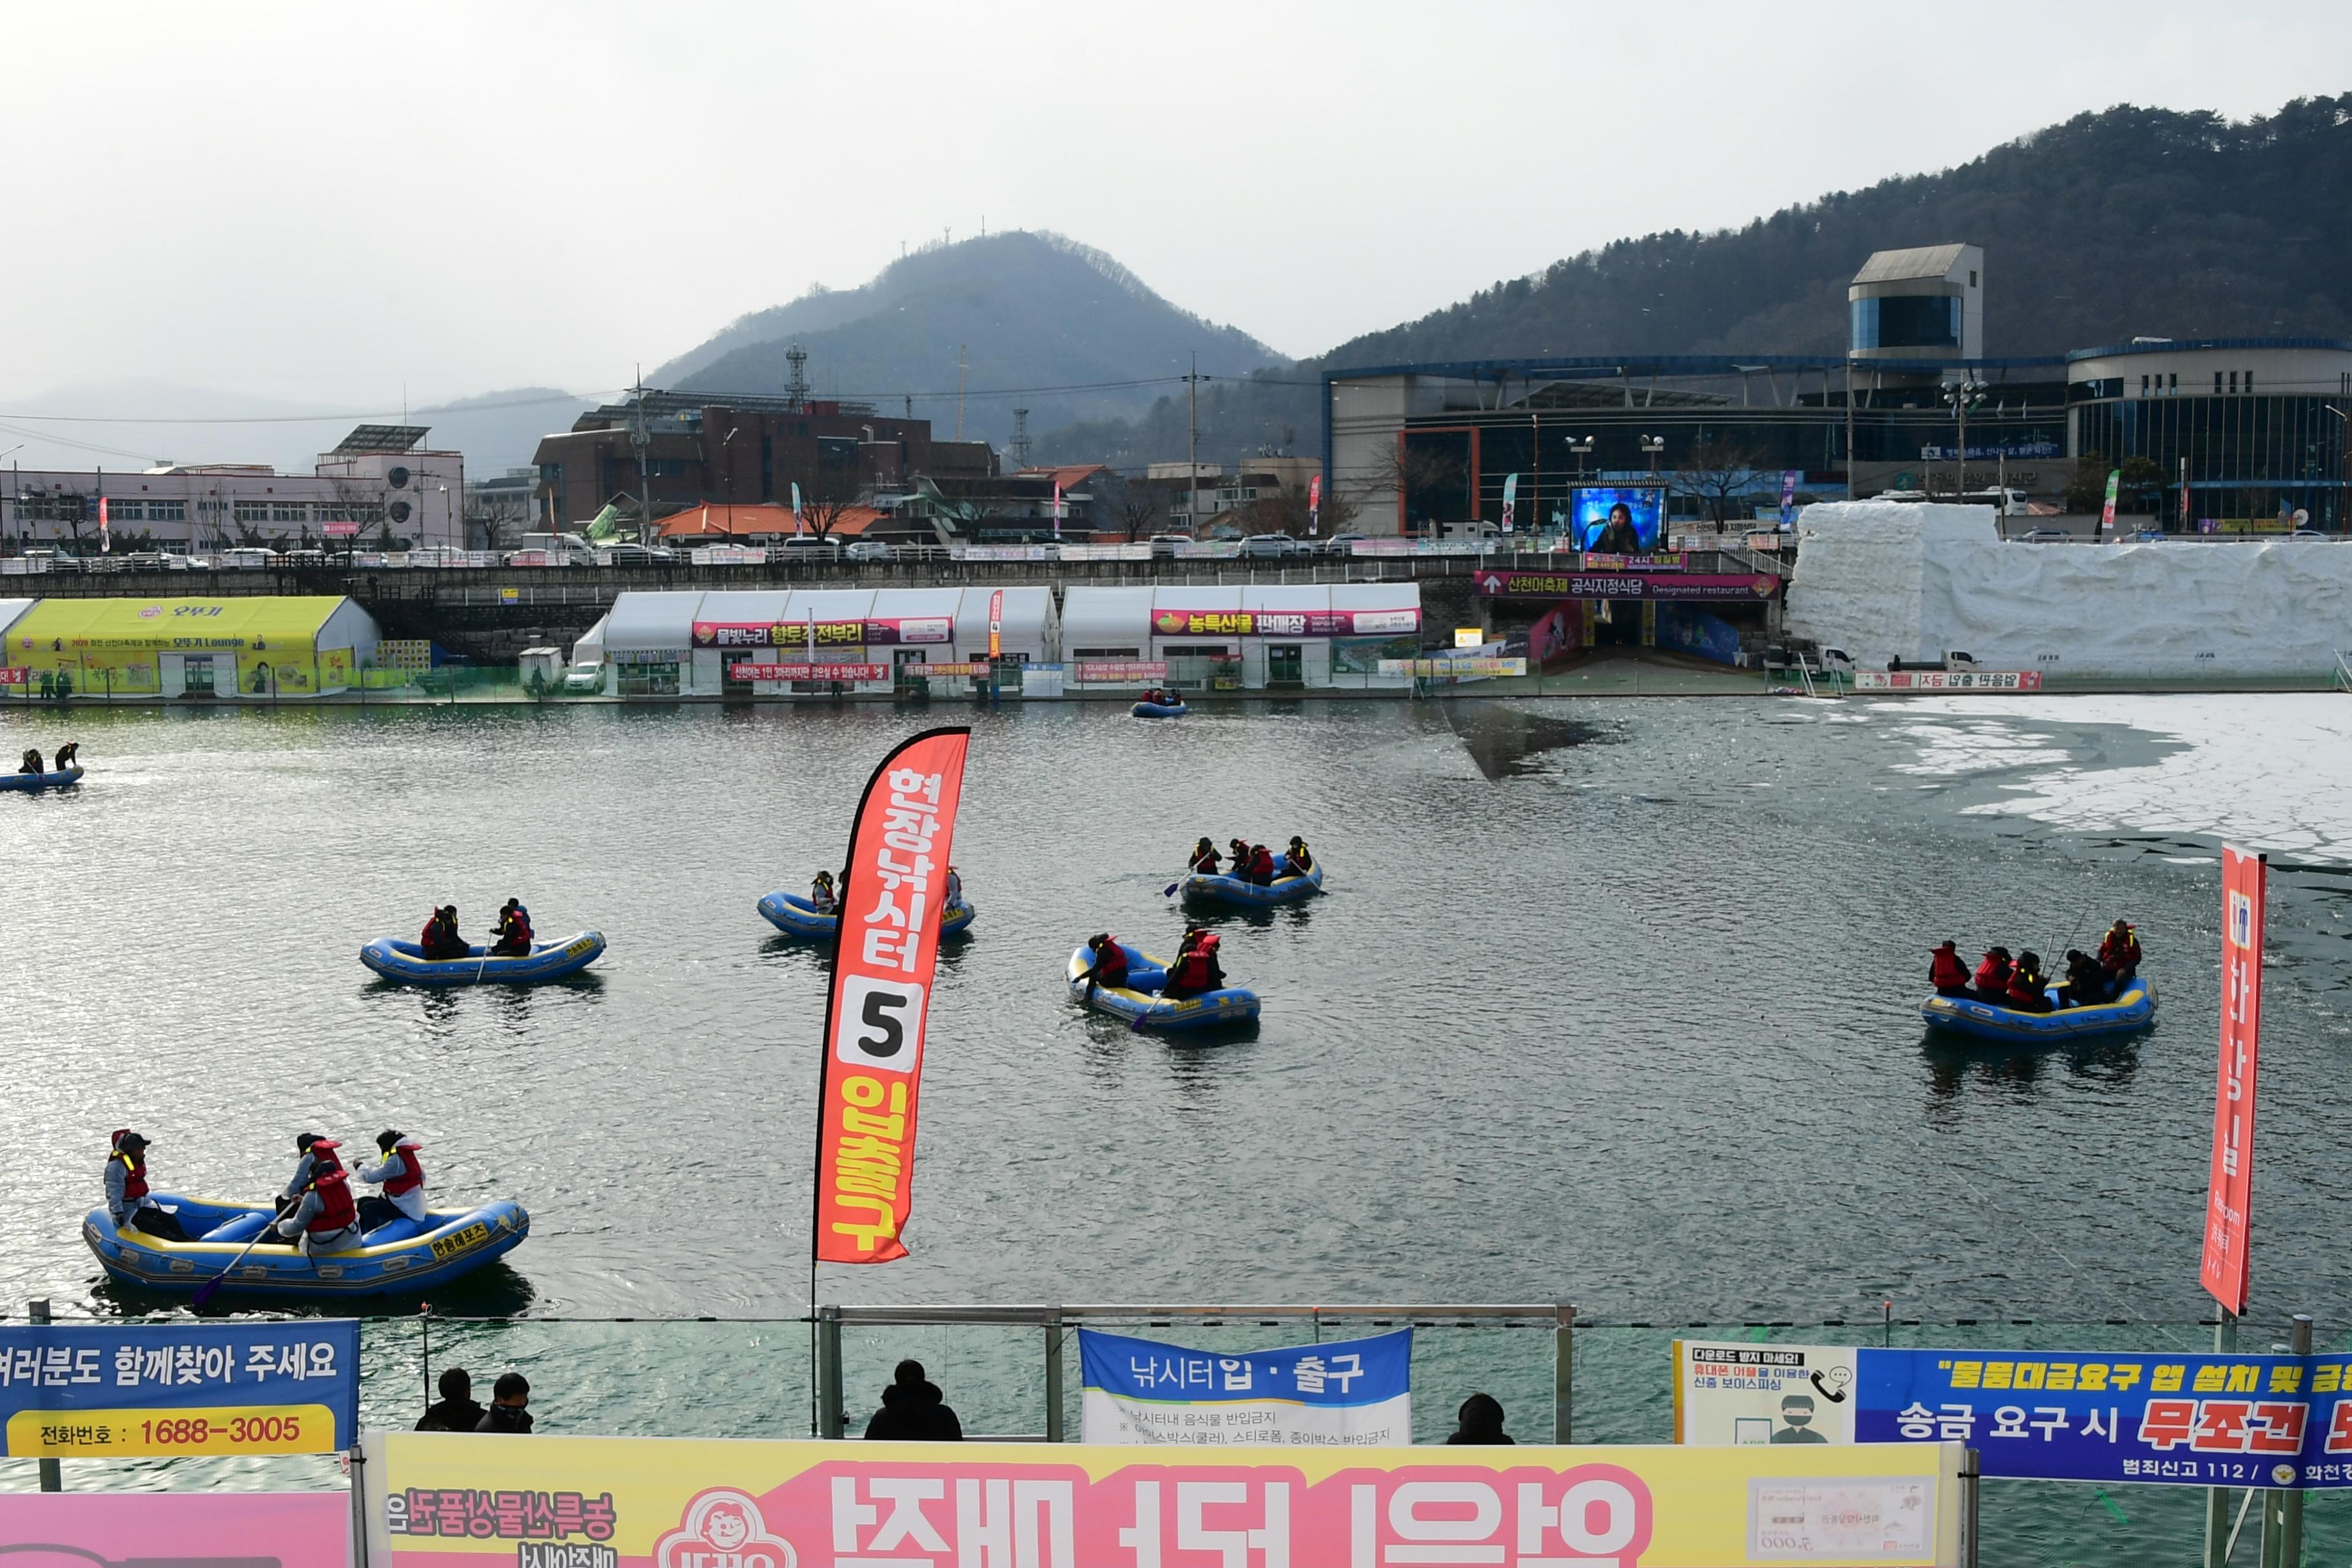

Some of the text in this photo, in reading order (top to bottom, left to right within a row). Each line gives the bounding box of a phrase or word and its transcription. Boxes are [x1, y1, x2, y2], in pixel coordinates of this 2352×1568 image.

[1696, 523, 1728, 533] 산천어제
[1509, 575, 1749, 596] 산천어축제 공식지정식당 Designated restaurant
[171, 606, 223, 616] 오뚜기
[1189, 614, 1252, 633] 농특산물
[1257, 614, 1306, 634] 판매장
[173, 638, 202, 647] 오뚜기
[205, 638, 244, 648] Lounge
[717, 627, 767, 644] 물빛누리
[735, 667, 760, 679] 산천어는
[762, 667, 772, 679] 1인
[774, 667, 809, 679] 3마리까지만
[832, 666, 839, 678] 수
[841, 665, 869, 678] 있습니다!
[865, 767, 941, 972] 현장낚시터
[858, 991, 907, 1058] 5
[832, 1075, 906, 1251] 입출구
[432, 1224, 486, 1256] 한솔레포츠
[2207, 1255, 2220, 1279] トイレ
[115, 1344, 235, 1386] 함께찾아
[245, 1342, 337, 1382] 주세요
[1694, 1349, 1798, 1364] 다운로드 받지 마세요!
[1694, 1364, 1810, 1379] 휴대폰 어플을 이용한
[2149, 1364, 2184, 1393] 앱
[2192, 1364, 2258, 1393] 설치
[2268, 1366, 2304, 1394] 및
[1694, 1377, 1781, 1391] 신종 보이스피싱
[1184, 1413, 1220, 1427] 음식물
[1226, 1411, 1275, 1426] 반입금지
[1896, 1400, 1975, 1440] 송금
[1990, 1405, 2069, 1442] 요구
[2081, 1405, 2117, 1443] 시
[2137, 1398, 2309, 1455] 무조건
[41, 1426, 113, 1446] 전화번호
[141, 1416, 300, 1445] 1688-3005
[1290, 1431, 1338, 1446] 종이박스
[1343, 1427, 1390, 1446] 반입금지
[2122, 1458, 2198, 1477] 범죄신고
[2208, 1463, 2244, 1478] 112
